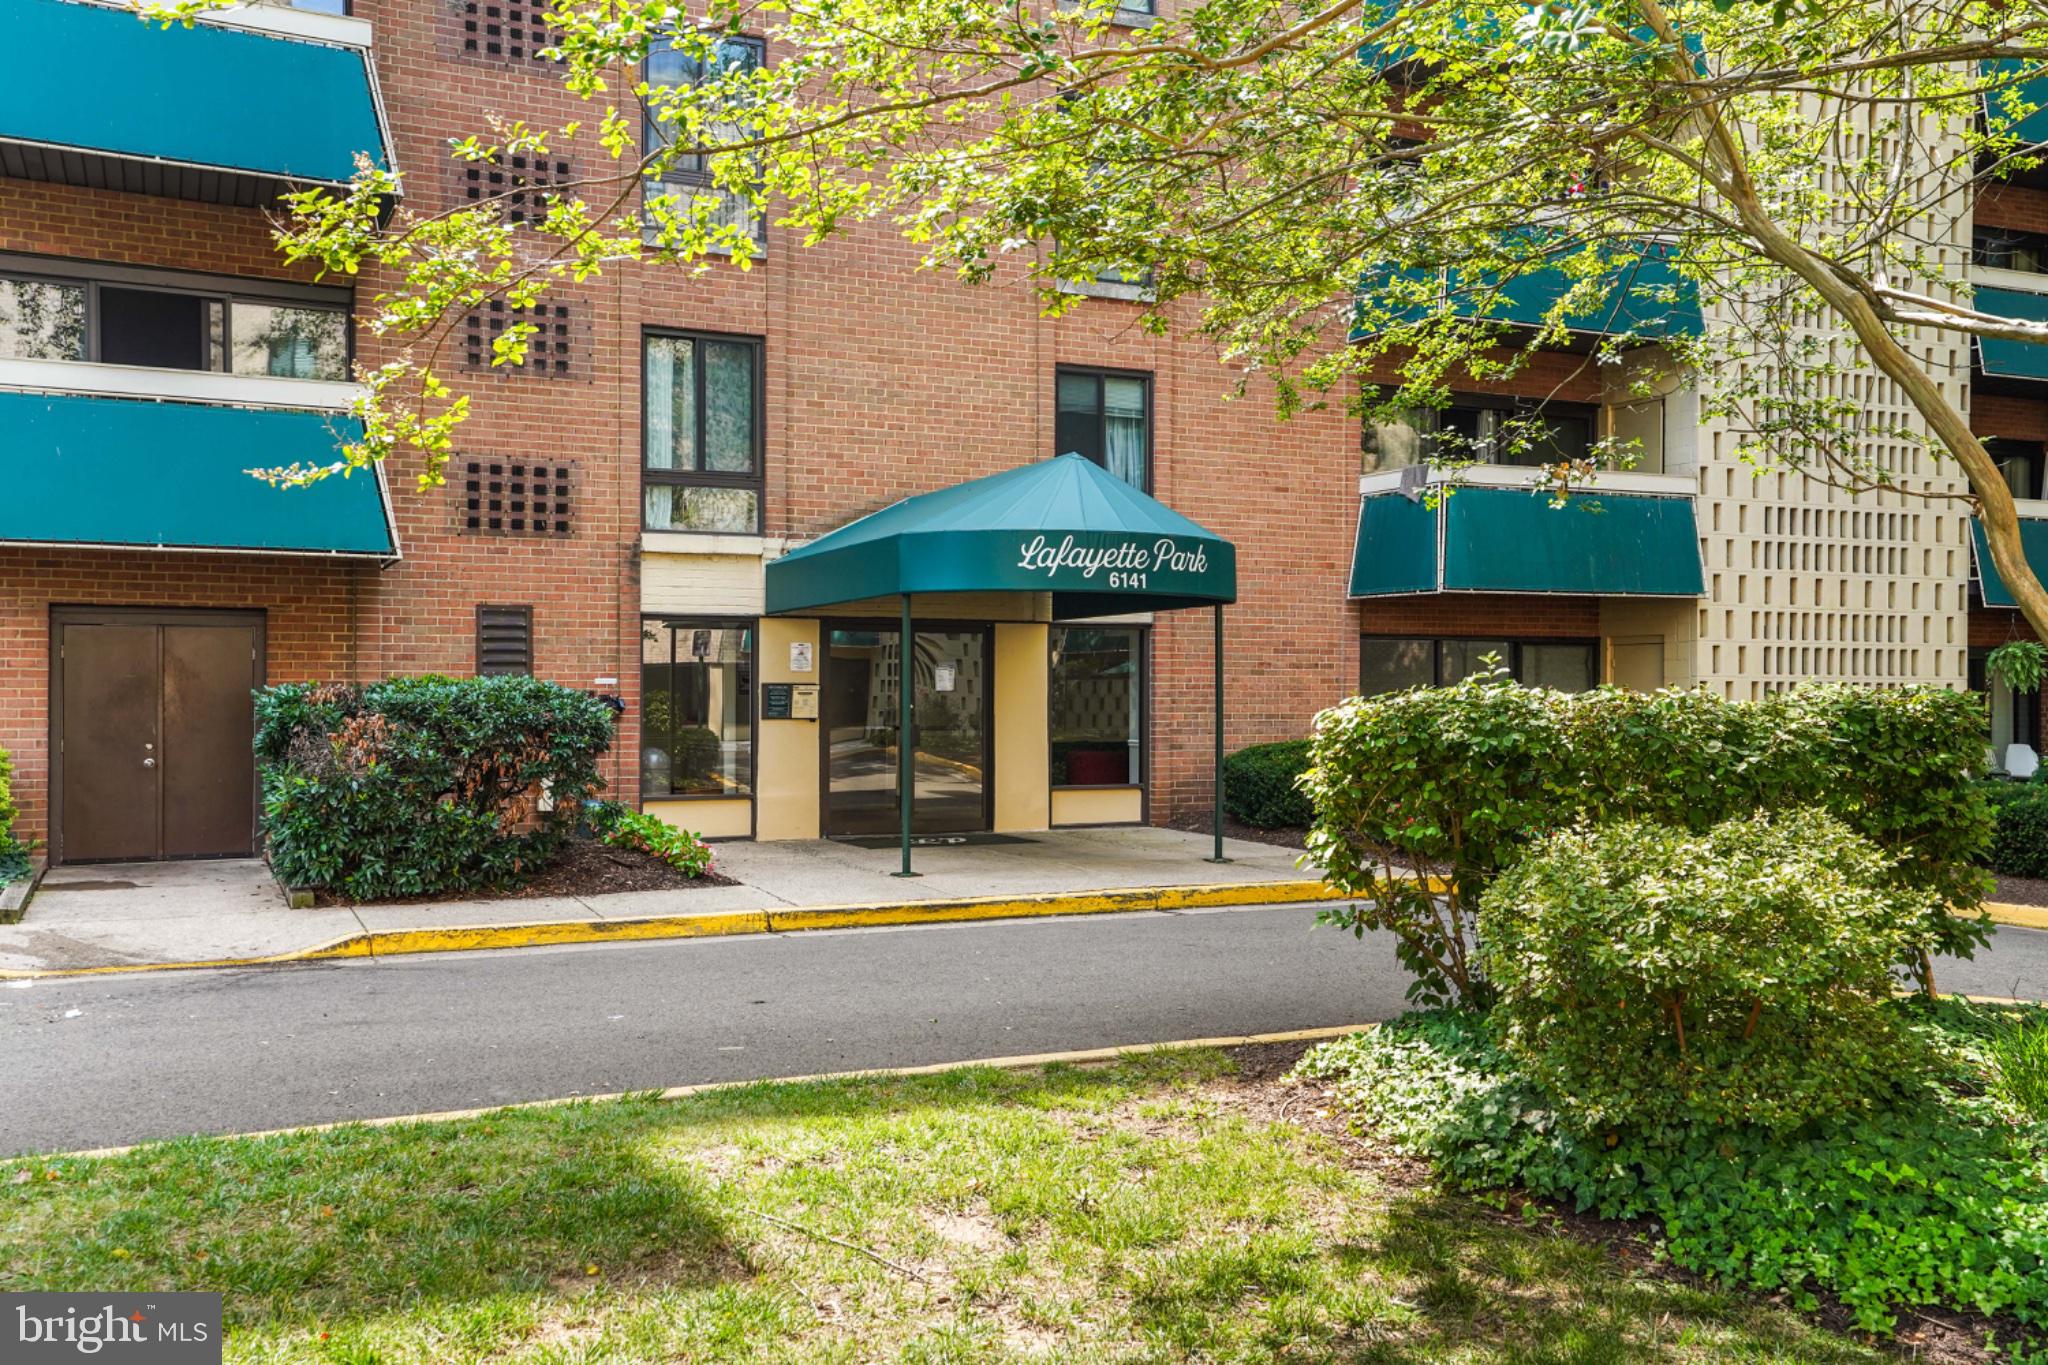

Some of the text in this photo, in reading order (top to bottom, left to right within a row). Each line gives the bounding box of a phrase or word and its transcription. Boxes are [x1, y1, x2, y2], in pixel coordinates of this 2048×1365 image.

[1017, 535, 1208, 578] Lafayette Park
[1109, 572, 1148, 589] 6141
